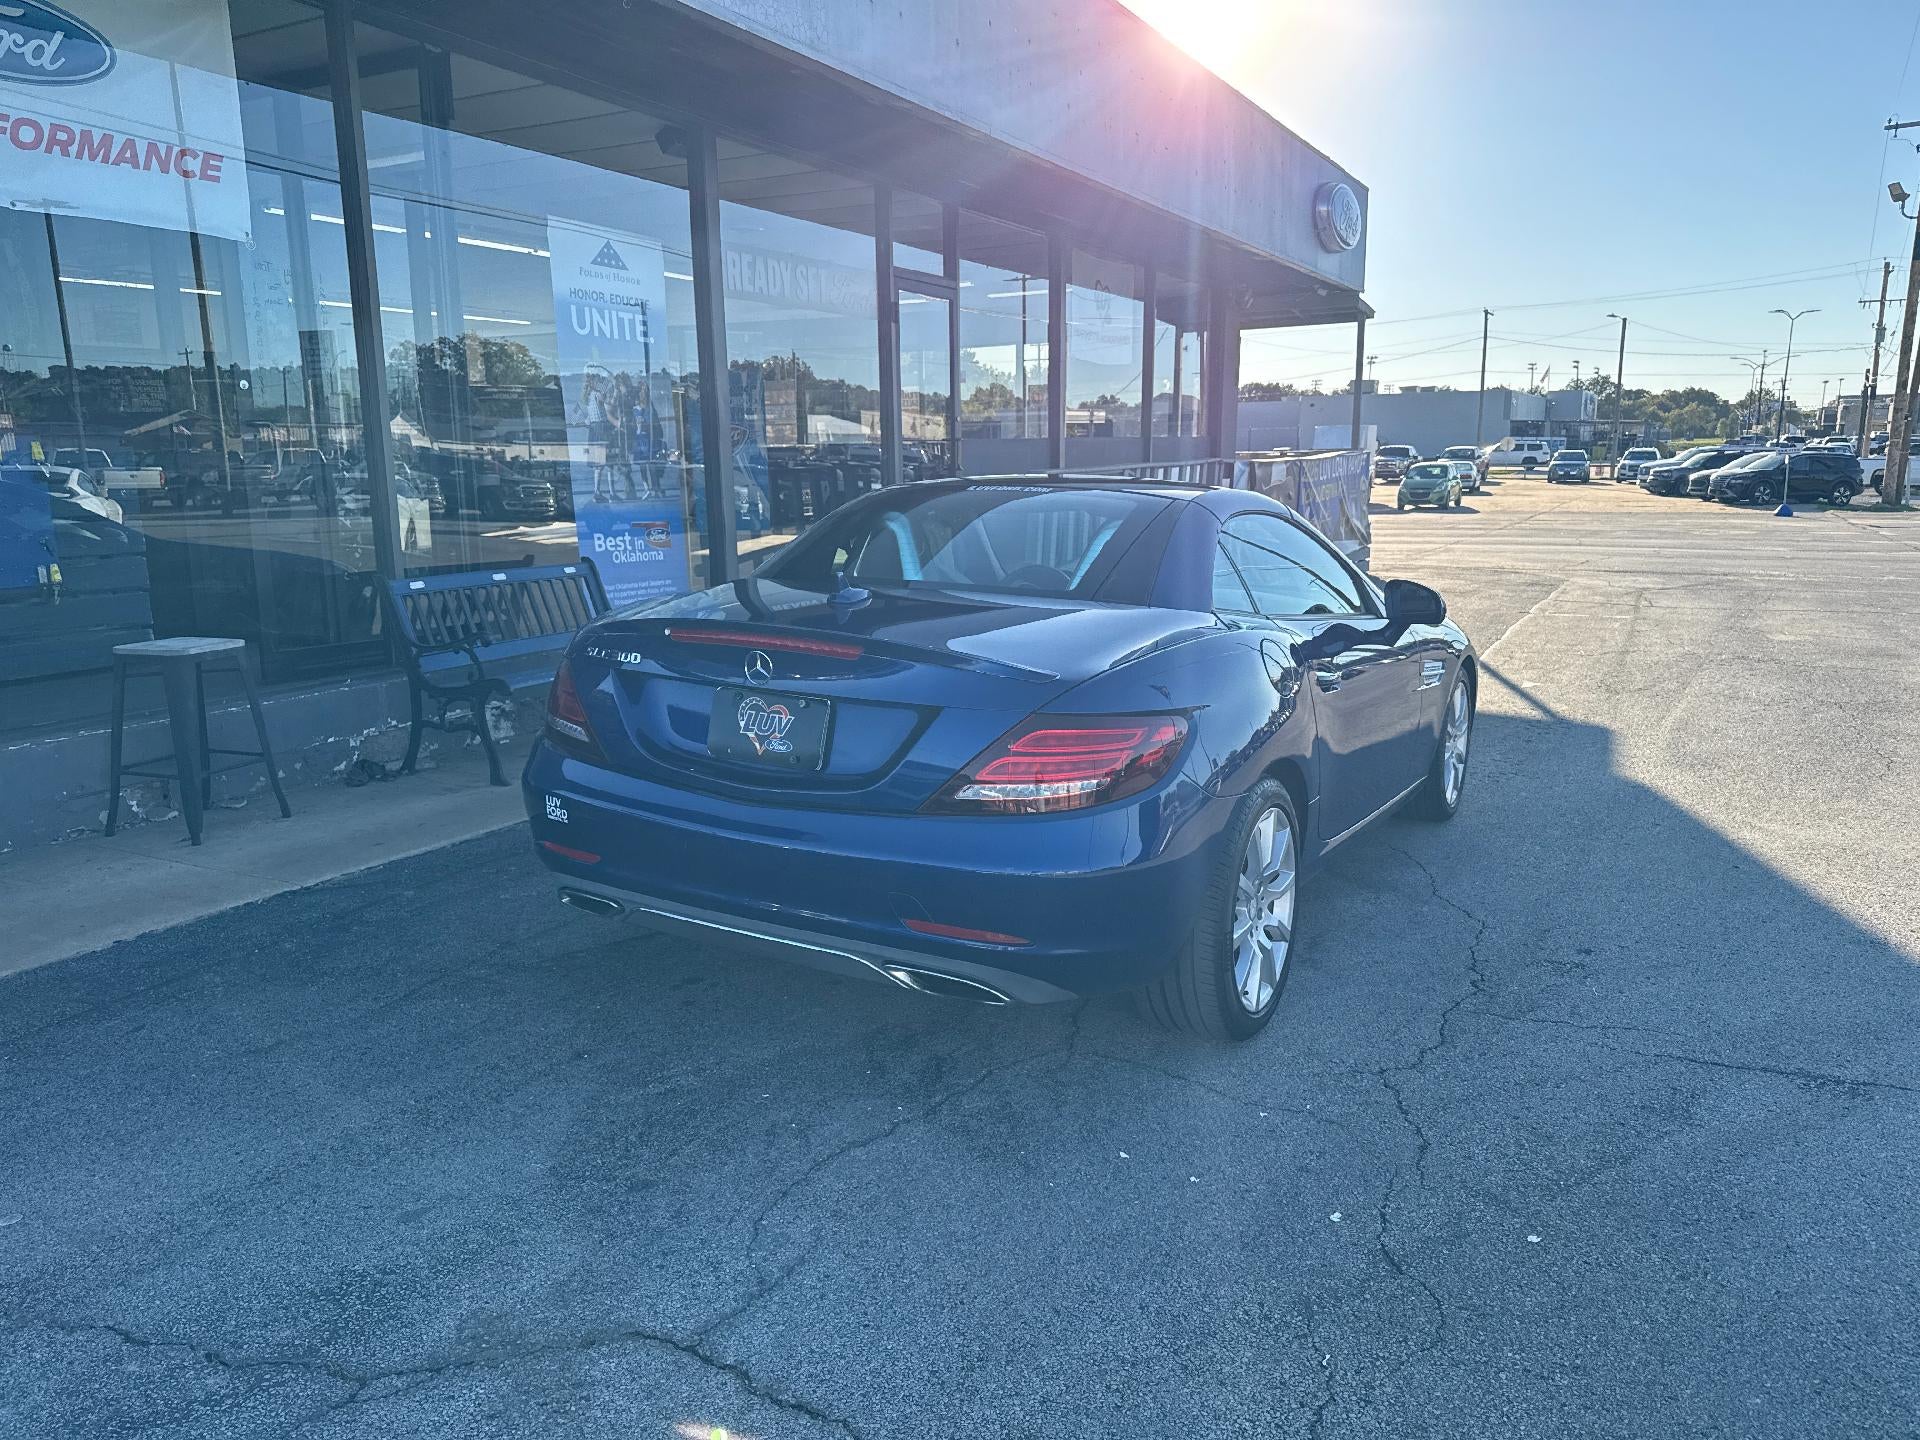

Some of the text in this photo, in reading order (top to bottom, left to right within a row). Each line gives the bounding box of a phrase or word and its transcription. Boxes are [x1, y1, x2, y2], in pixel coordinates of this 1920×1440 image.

[726, 249, 791, 299] READY
[570, 304, 655, 344] UNITE.
[593, 531, 645, 552] Best in
[612, 550, 664, 564] Oklahoma
[740, 710, 795, 737] LUV
[545, 794, 562, 808] LUV
[546, 804, 568, 819] FORD
